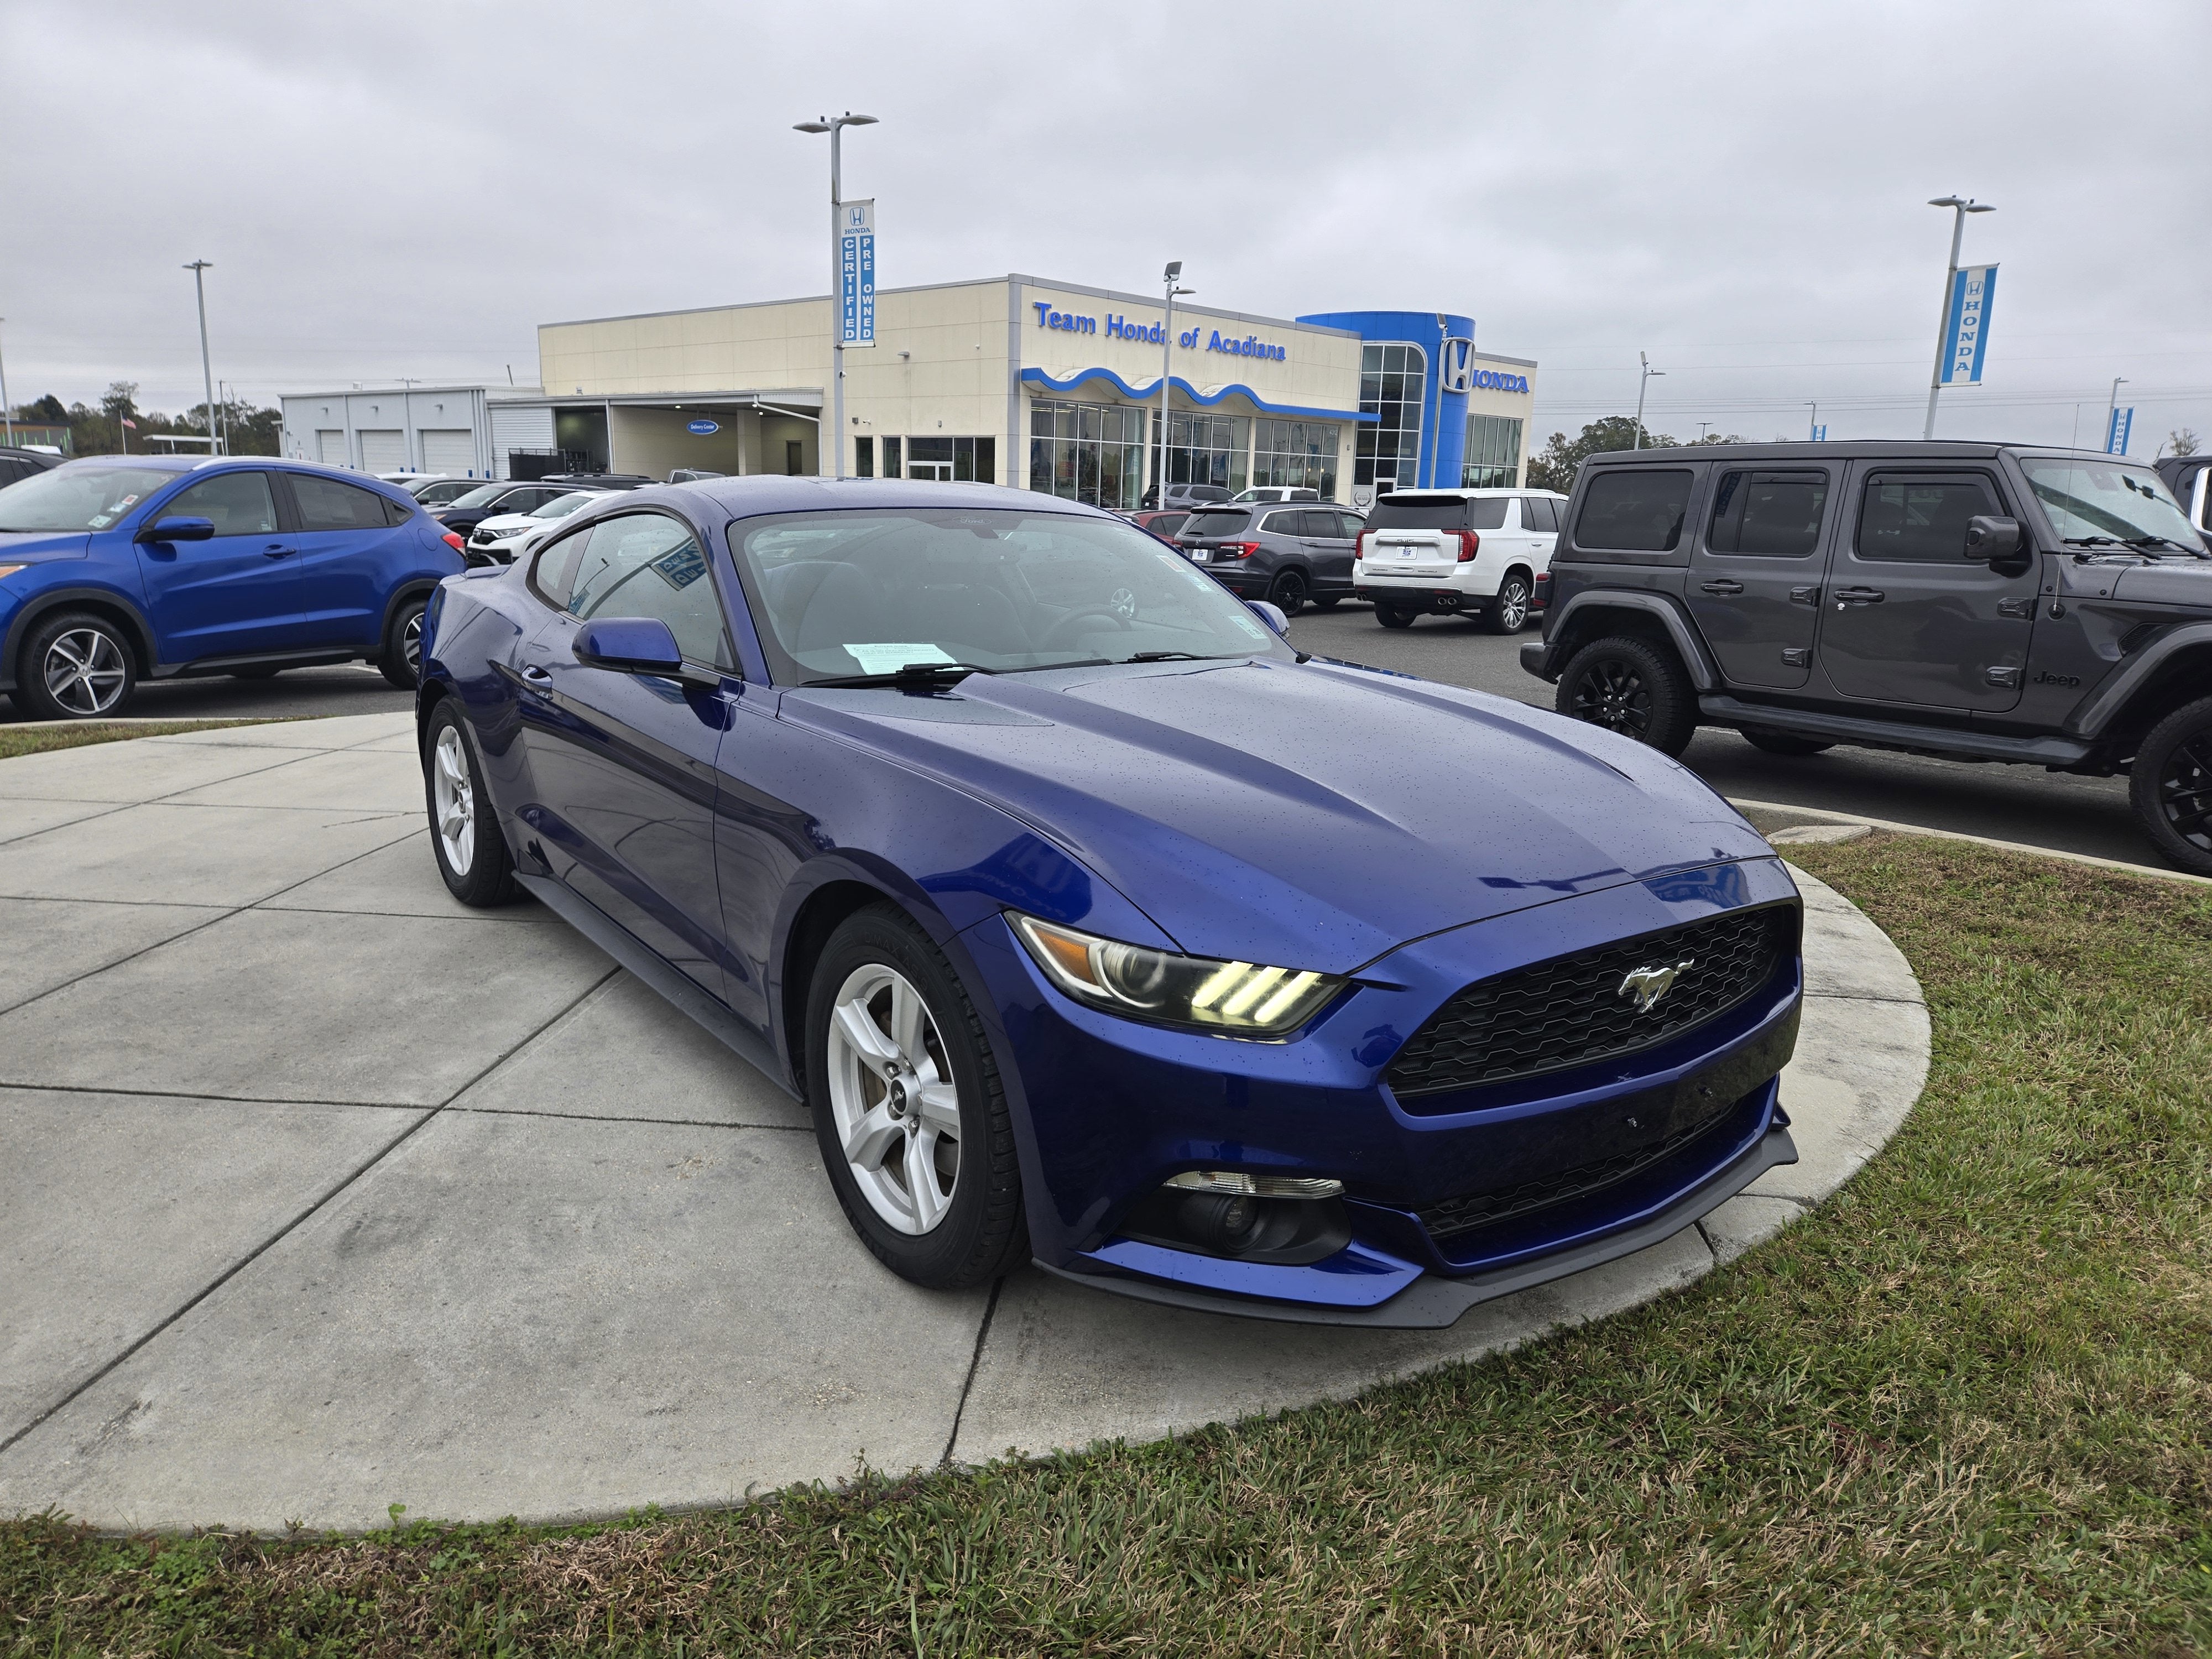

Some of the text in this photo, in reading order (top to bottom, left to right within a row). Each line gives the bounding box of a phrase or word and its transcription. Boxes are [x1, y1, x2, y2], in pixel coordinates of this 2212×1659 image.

[844, 239, 855, 339] CERTIFIED
[862, 238, 873, 338] PRE OWNED
[1032, 301, 1096, 334] Team
[1178, 327, 1201, 349] of
[1206, 328, 1286, 361] Acadiana
[1954, 301, 1980, 371] HONDA
[2113, 421, 2125, 452] HONDA
[2033, 668, 2081, 690] Jeep
